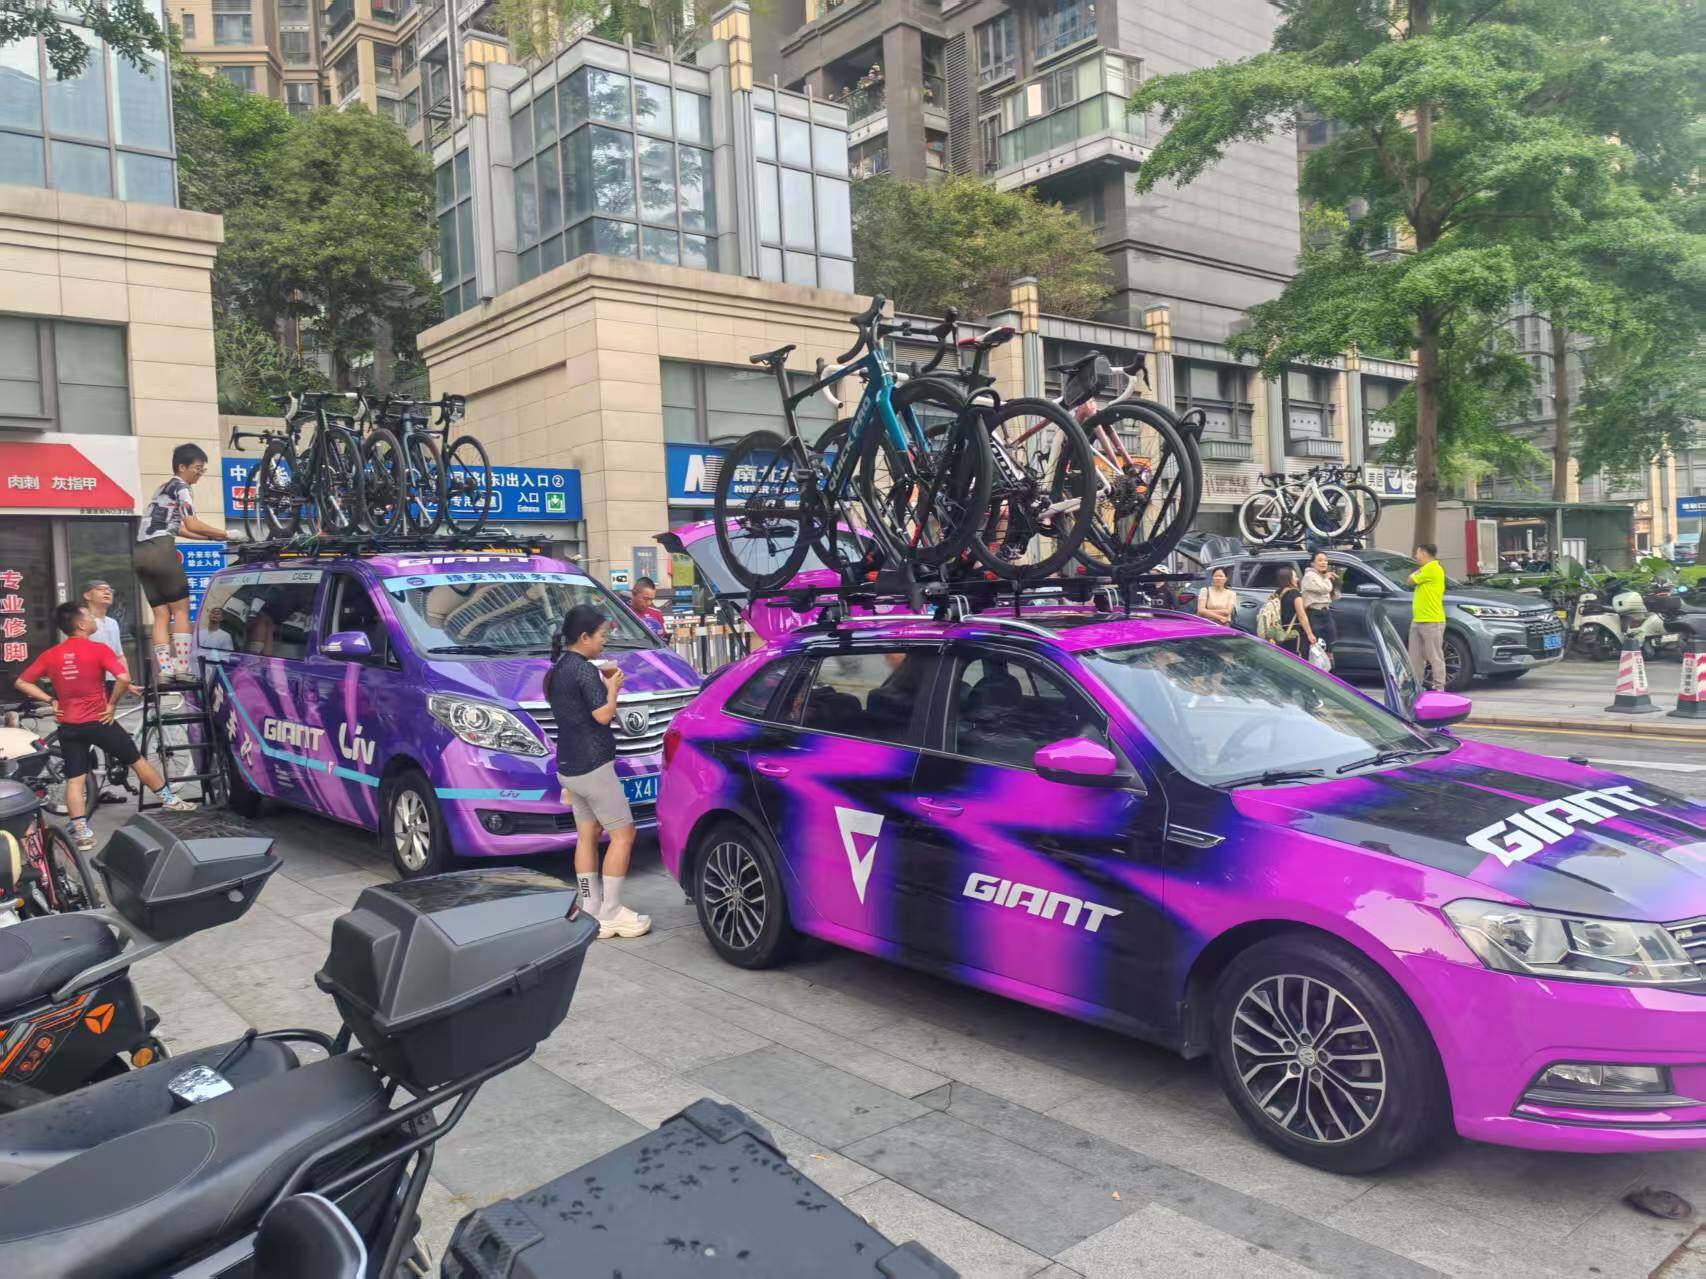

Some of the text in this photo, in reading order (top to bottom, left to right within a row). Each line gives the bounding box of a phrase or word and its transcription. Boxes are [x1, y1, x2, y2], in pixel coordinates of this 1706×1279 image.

[8, 475, 97, 490] 肉刺 灰指甲
[517, 491, 539, 503] 入口
[0, 569, 28, 662] 专业修脚
[264, 718, 376, 766] GIANT Liv
[1466, 785, 1660, 868] GIANT
[962, 872, 1125, 933] GIANT
